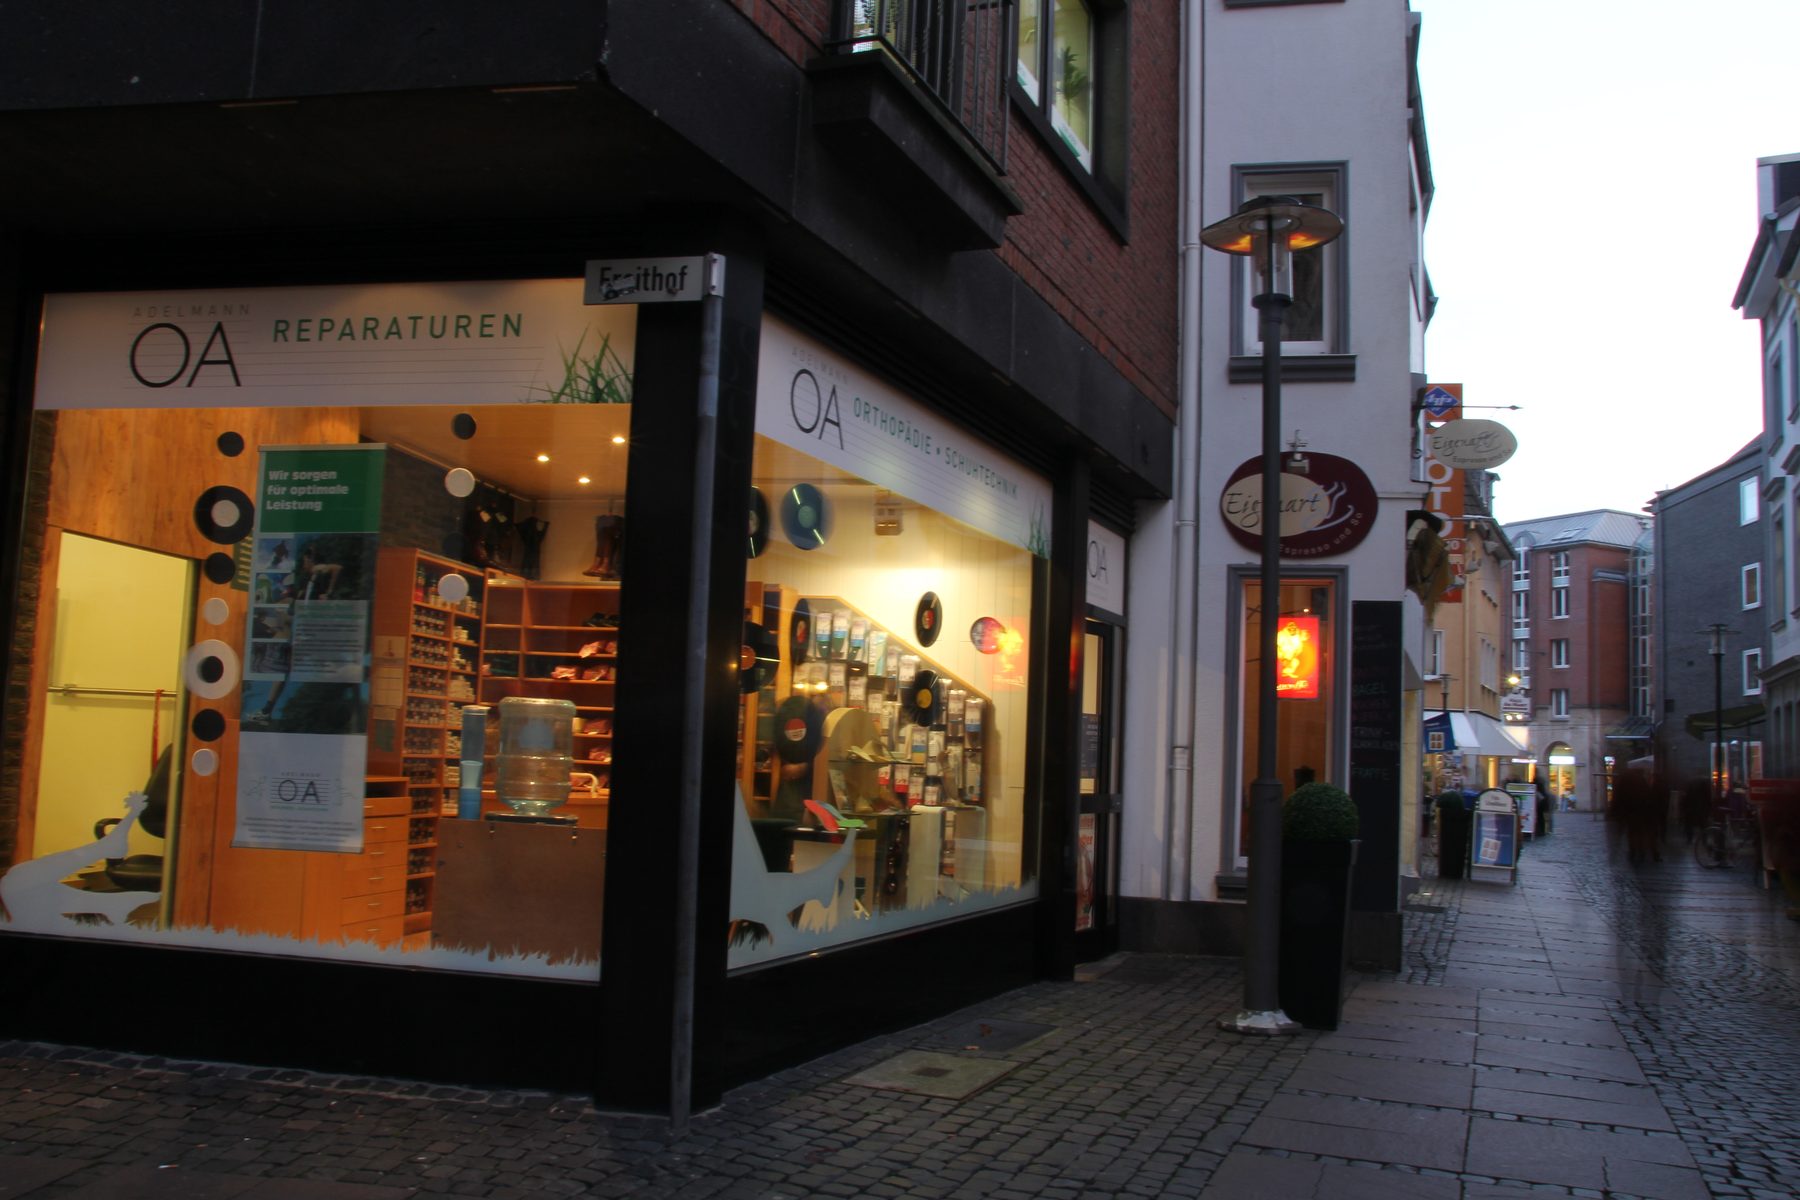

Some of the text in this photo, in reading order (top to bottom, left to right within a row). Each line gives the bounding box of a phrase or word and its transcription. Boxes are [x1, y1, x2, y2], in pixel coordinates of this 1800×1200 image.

[272, 313, 523, 343] REPARATUREN
[129, 321, 241, 388] OA
[790, 368, 844, 450] OA
[852, 396, 1020, 499] ORTHOPÄDIE SCHUHTECHNIK
[268, 470, 337, 482] Wir sorgen
[290, 483, 349, 497] optimale
[266, 500, 323, 511] Leistung
[1226, 492, 1322, 528] Eigart
[278, 779, 321, 804] OA
